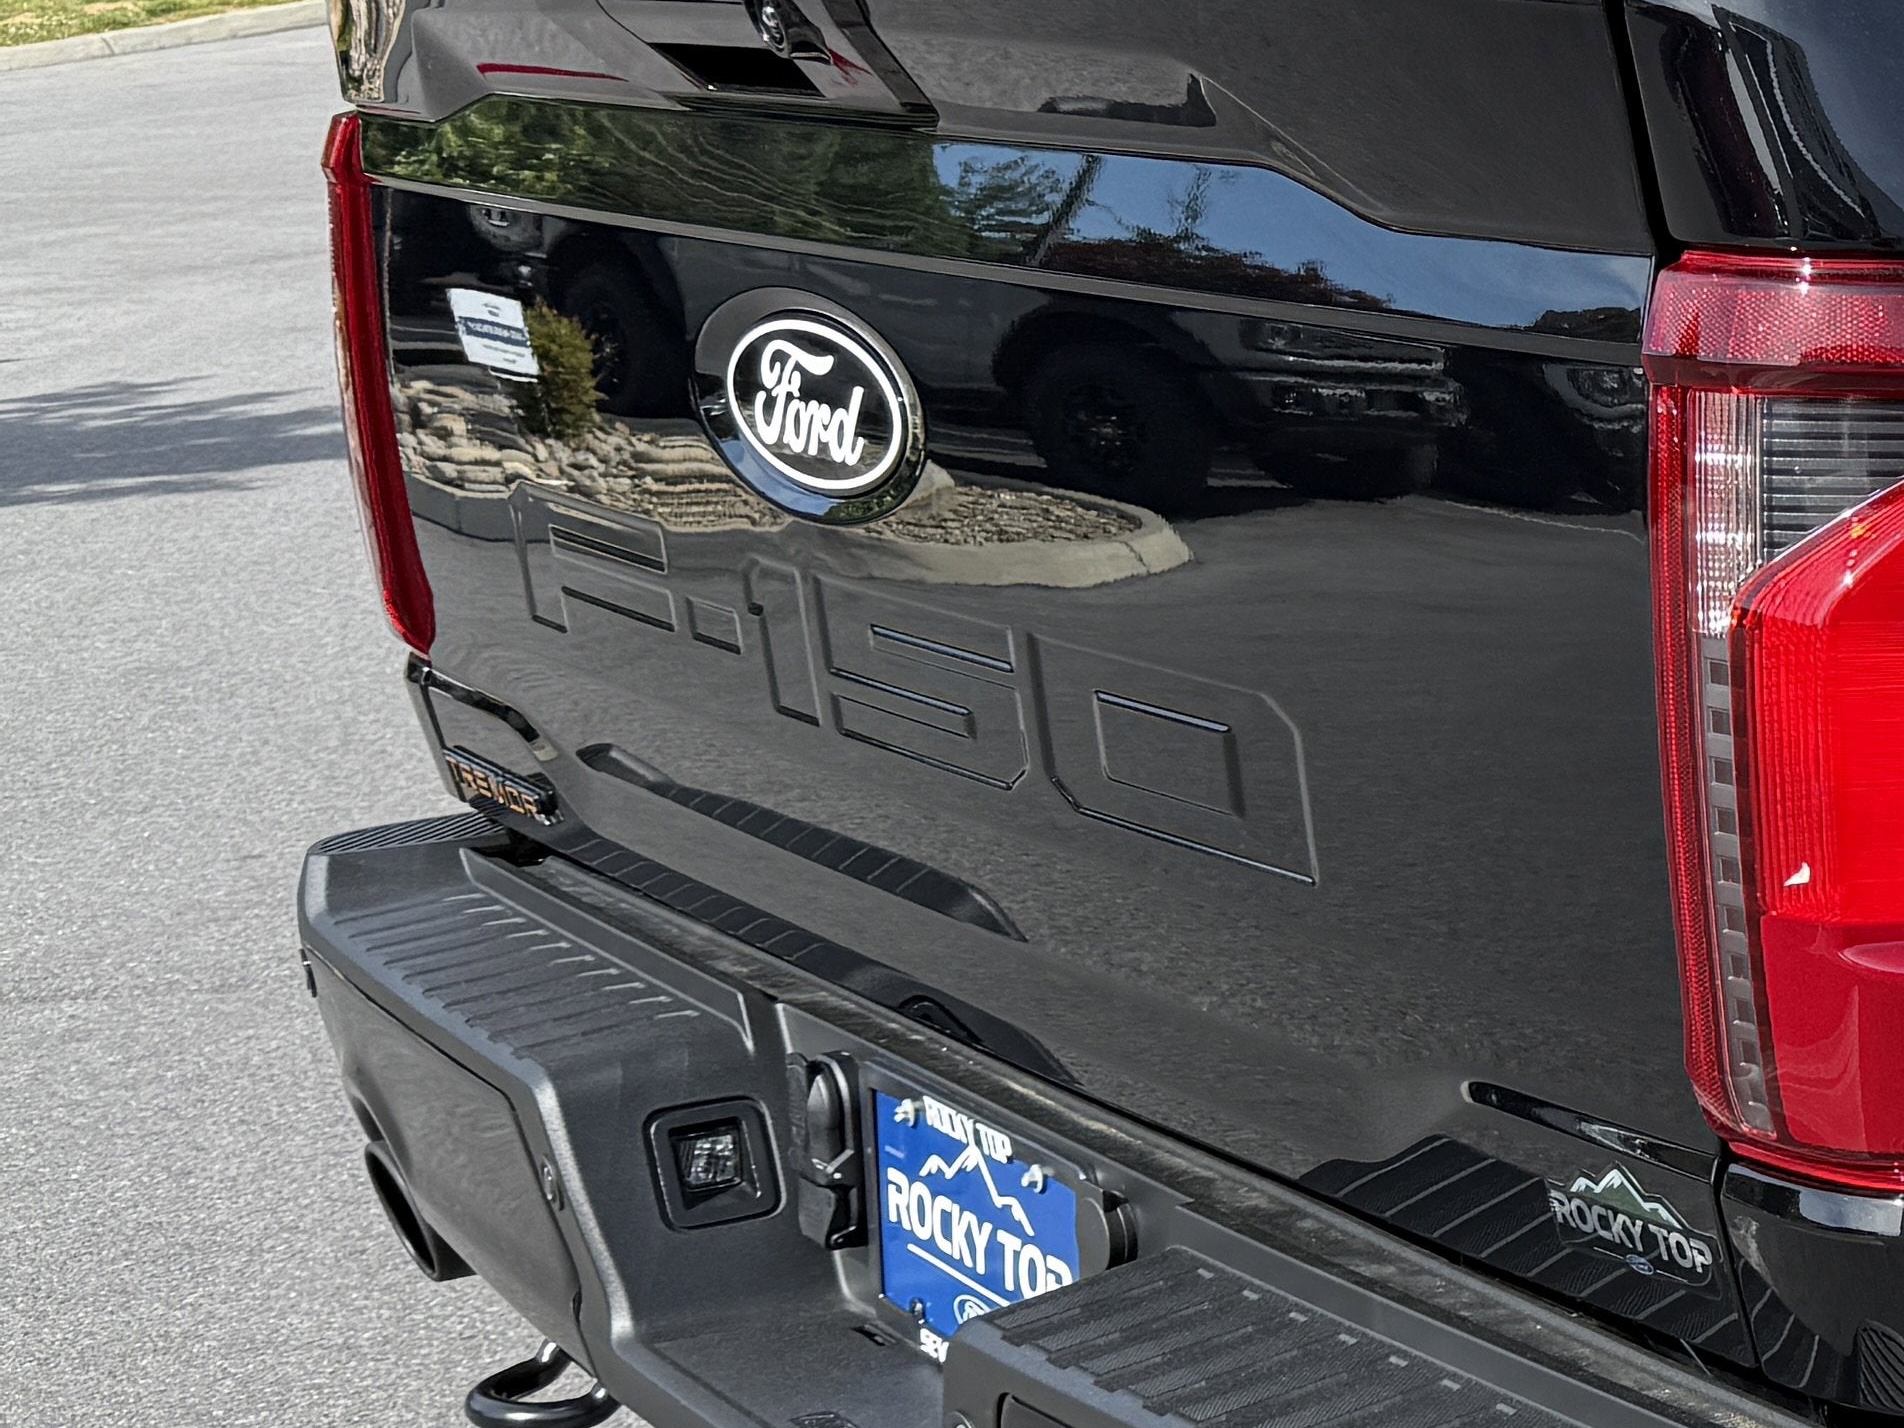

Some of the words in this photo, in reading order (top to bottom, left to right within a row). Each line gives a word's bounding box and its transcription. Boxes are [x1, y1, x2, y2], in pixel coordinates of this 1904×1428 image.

[755, 338, 866, 467] Ford
[508, 480, 1321, 888] F-150
[445, 754, 541, 820] TREMOR
[922, 1095, 975, 1147] ROCKY
[976, 1123, 1012, 1164] TOP
[887, 1167, 993, 1275] ROCKY
[997, 1229, 1074, 1300] TOP
[1549, 1189, 1644, 1253] ROCKY
[1648, 1223, 1713, 1274] TOP
